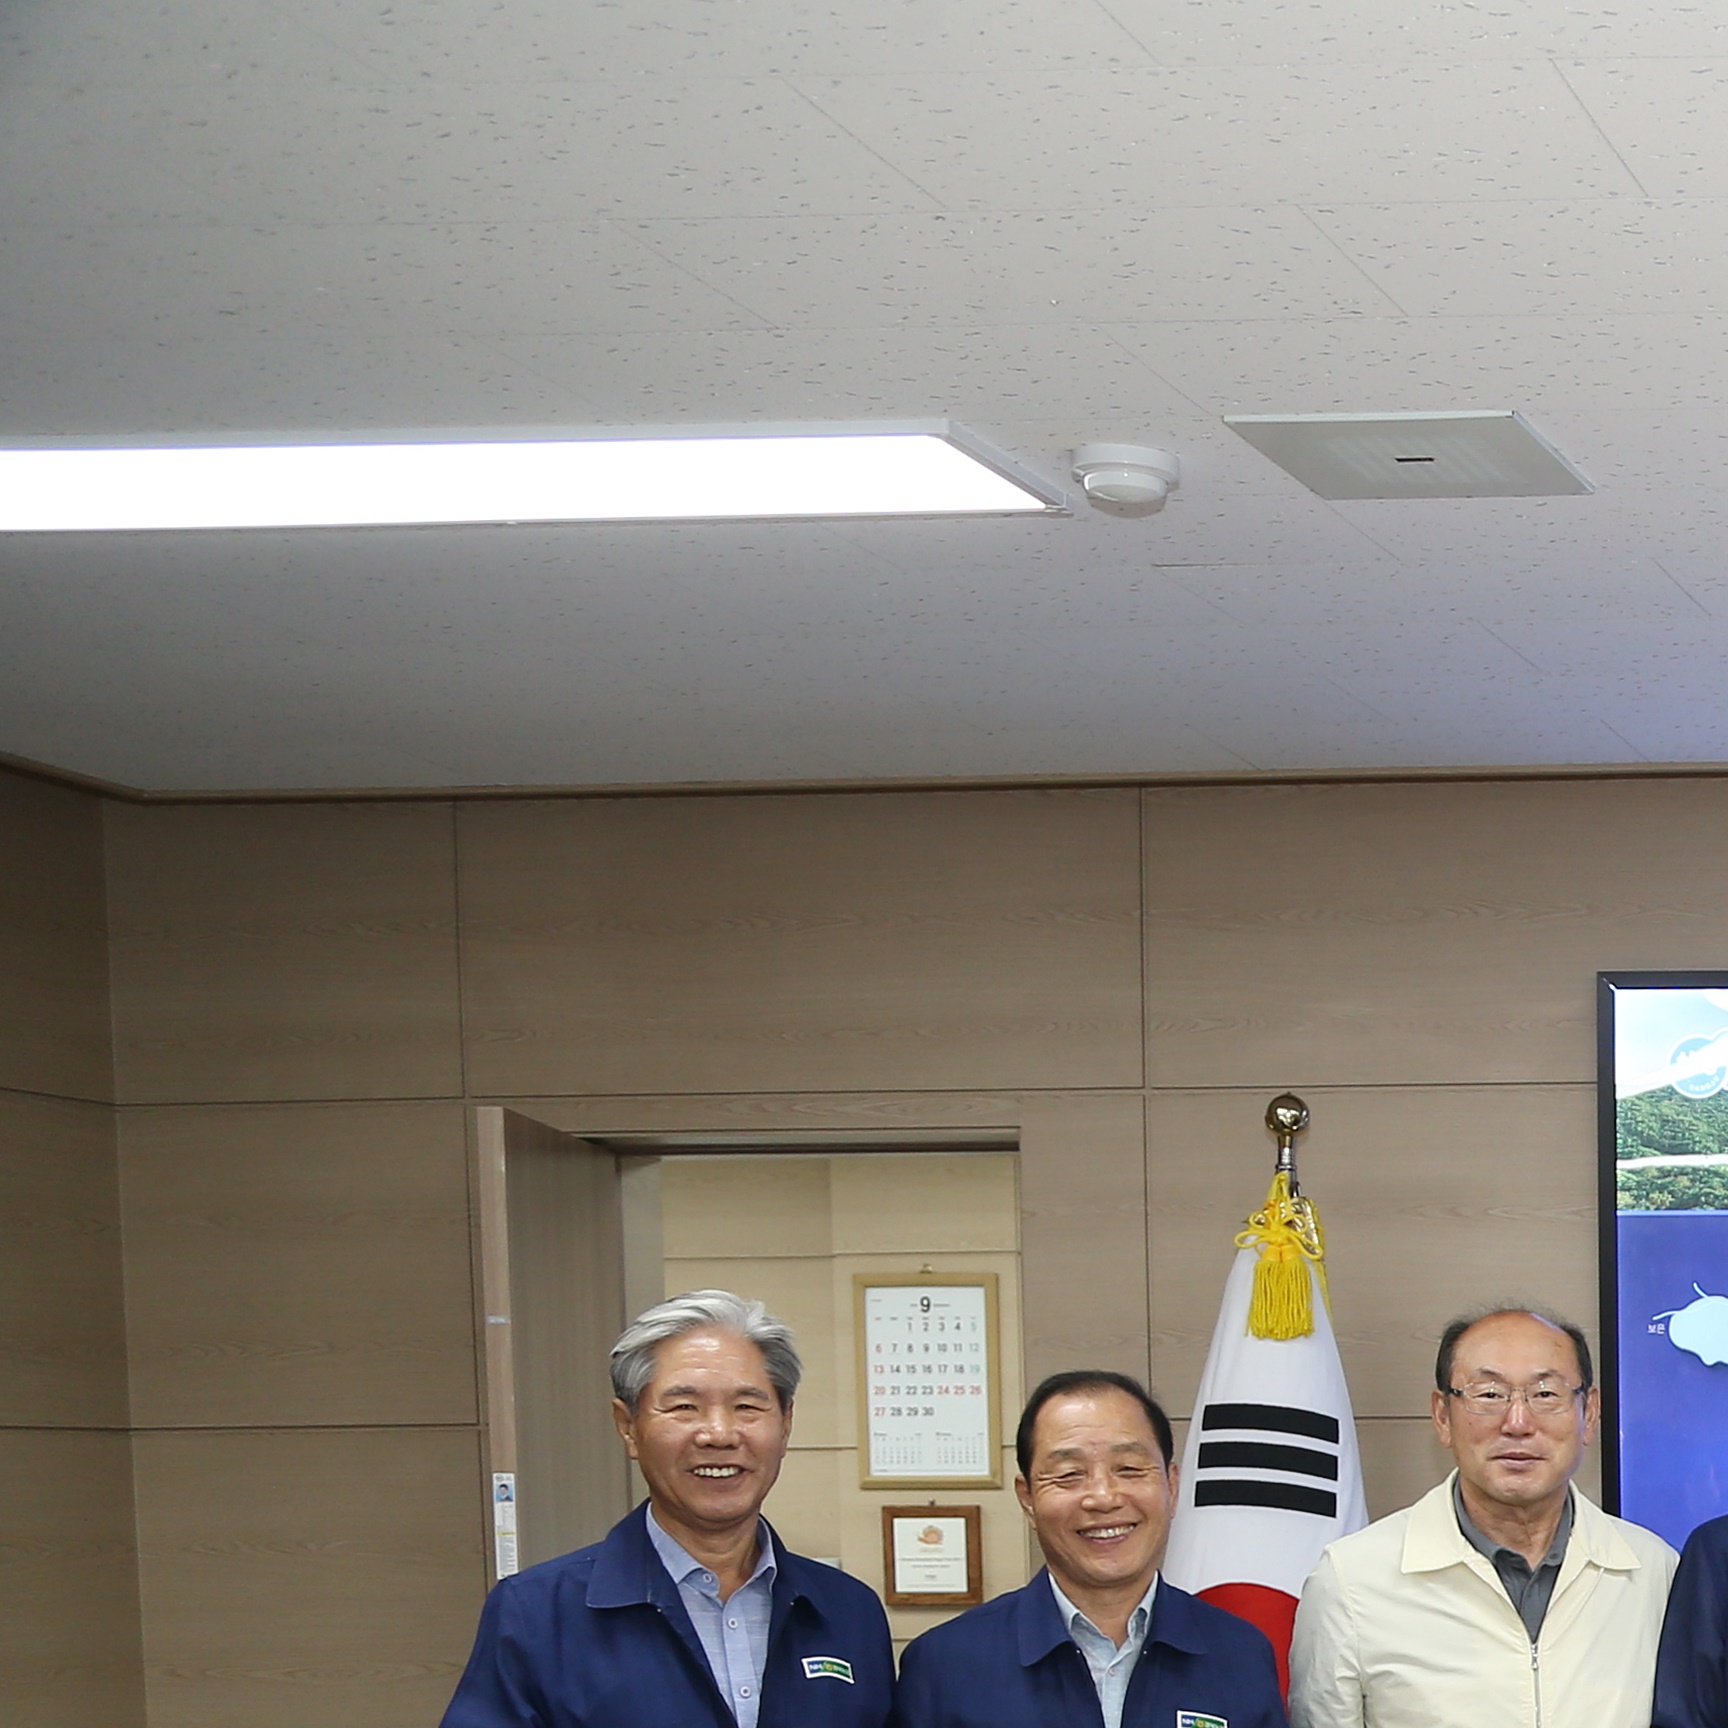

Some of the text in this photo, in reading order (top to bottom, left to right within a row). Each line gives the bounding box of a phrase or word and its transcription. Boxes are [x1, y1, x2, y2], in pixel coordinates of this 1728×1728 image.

[920, 1296, 931, 1313] 9
[907, 1322, 977, 1332] 1 2 3 4 5
[875, 1343, 979, 1353] 6 7 8 9 10 11 12
[874, 1364, 981, 1374] 13 14 15 16 17 18 19
[874, 1386, 982, 1395] 20 21 22 23 24 25 26
[874, 1407, 935, 1416] 27 28 29 30
